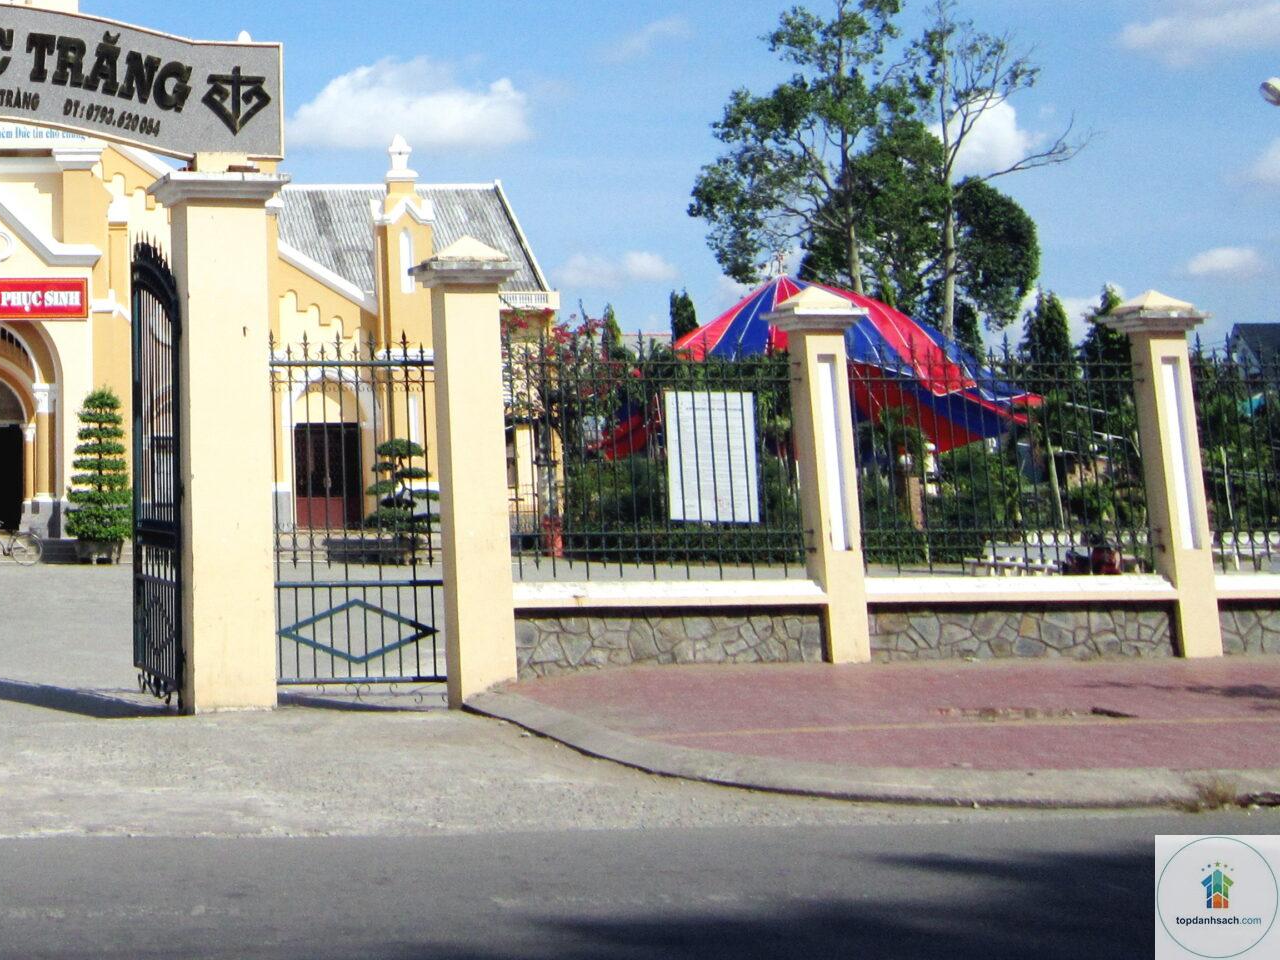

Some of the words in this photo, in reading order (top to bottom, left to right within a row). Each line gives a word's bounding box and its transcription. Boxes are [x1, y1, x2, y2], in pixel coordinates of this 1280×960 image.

[25, 30, 192, 113] TRĂNG
[1, 290, 43, 313] PHỤC
[43, 290, 82, 307] SINH
